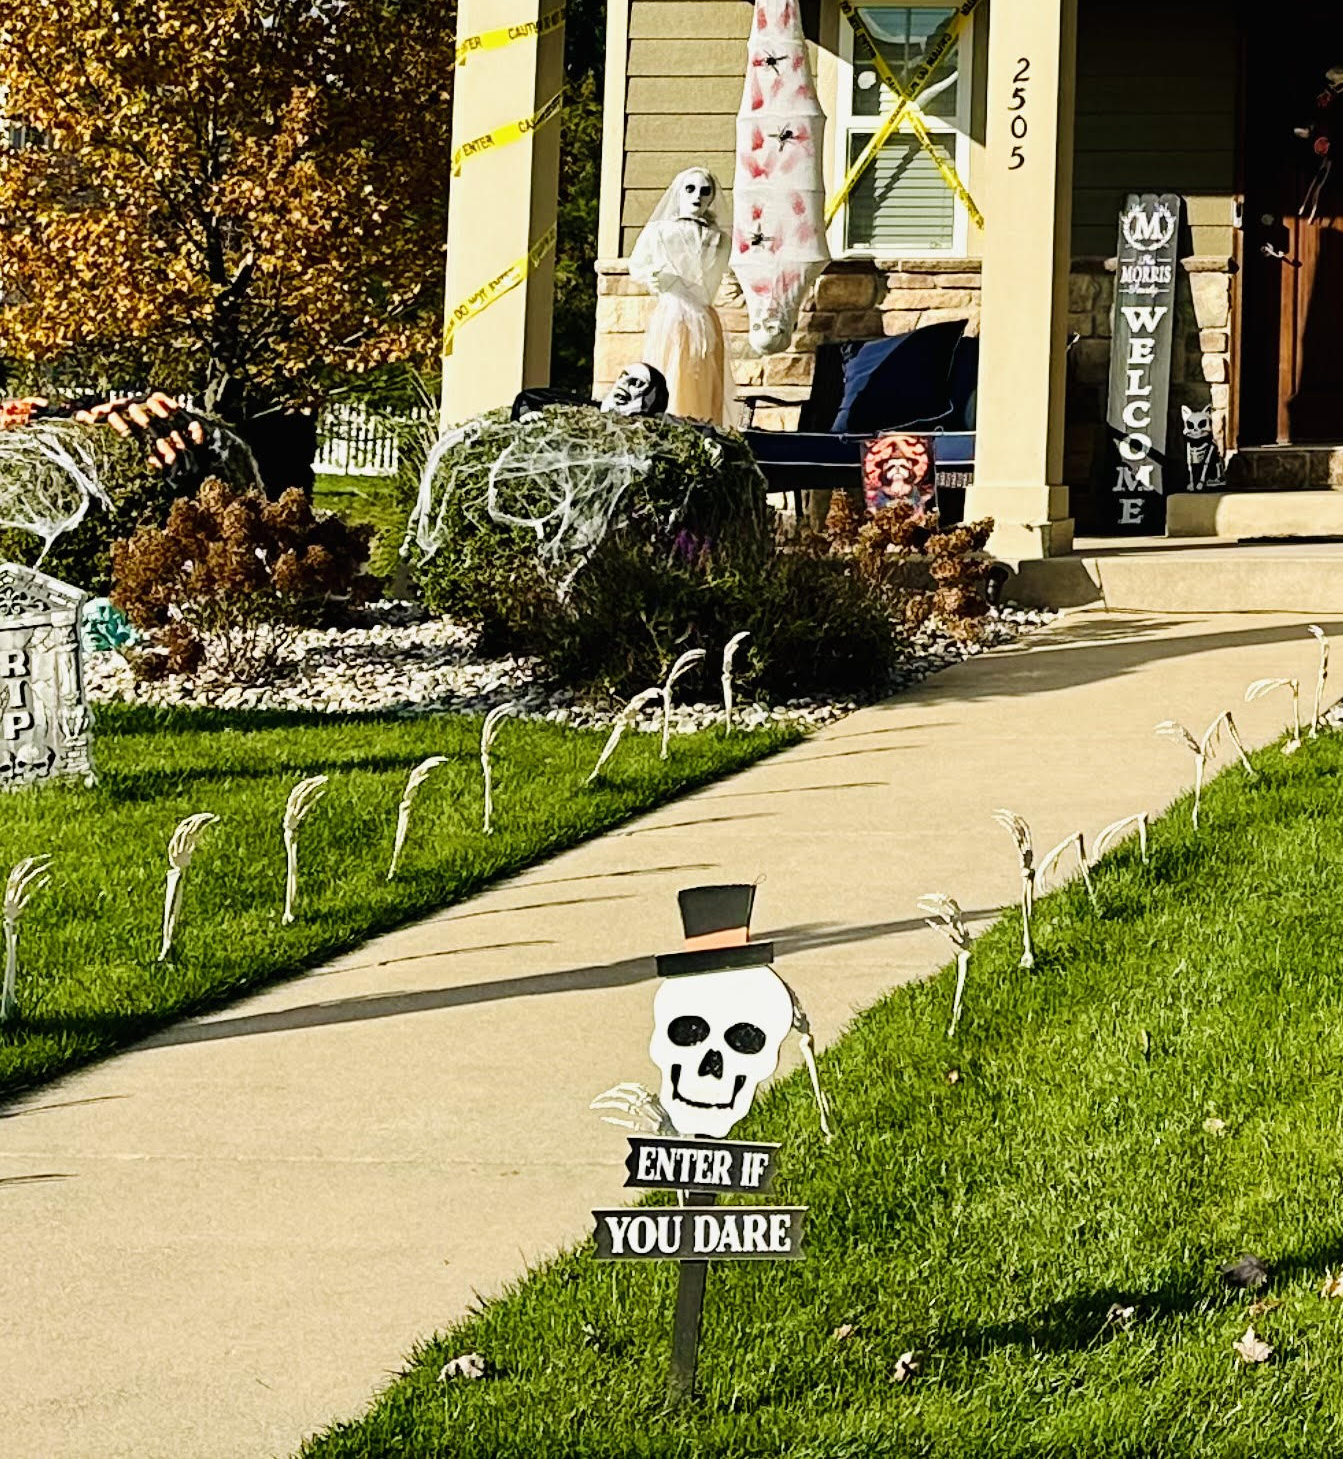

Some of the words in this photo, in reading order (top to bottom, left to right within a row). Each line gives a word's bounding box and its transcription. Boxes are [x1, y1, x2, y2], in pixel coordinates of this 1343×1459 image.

[1007, 57, 1030, 170] 2505
[462, 134, 496, 157] ENTER
[1132, 211, 1164, 241] M
[1120, 265, 1172, 284] MORRIS
[1112, 305, 1168, 525] WELCOME
[0, 648, 34, 741] RIP
[636, 1145, 733, 1186] ENTER
[739, 1152, 769, 1188] IF
[604, 1215, 683, 1255] YOU
[693, 1213, 792, 1254] DARE
